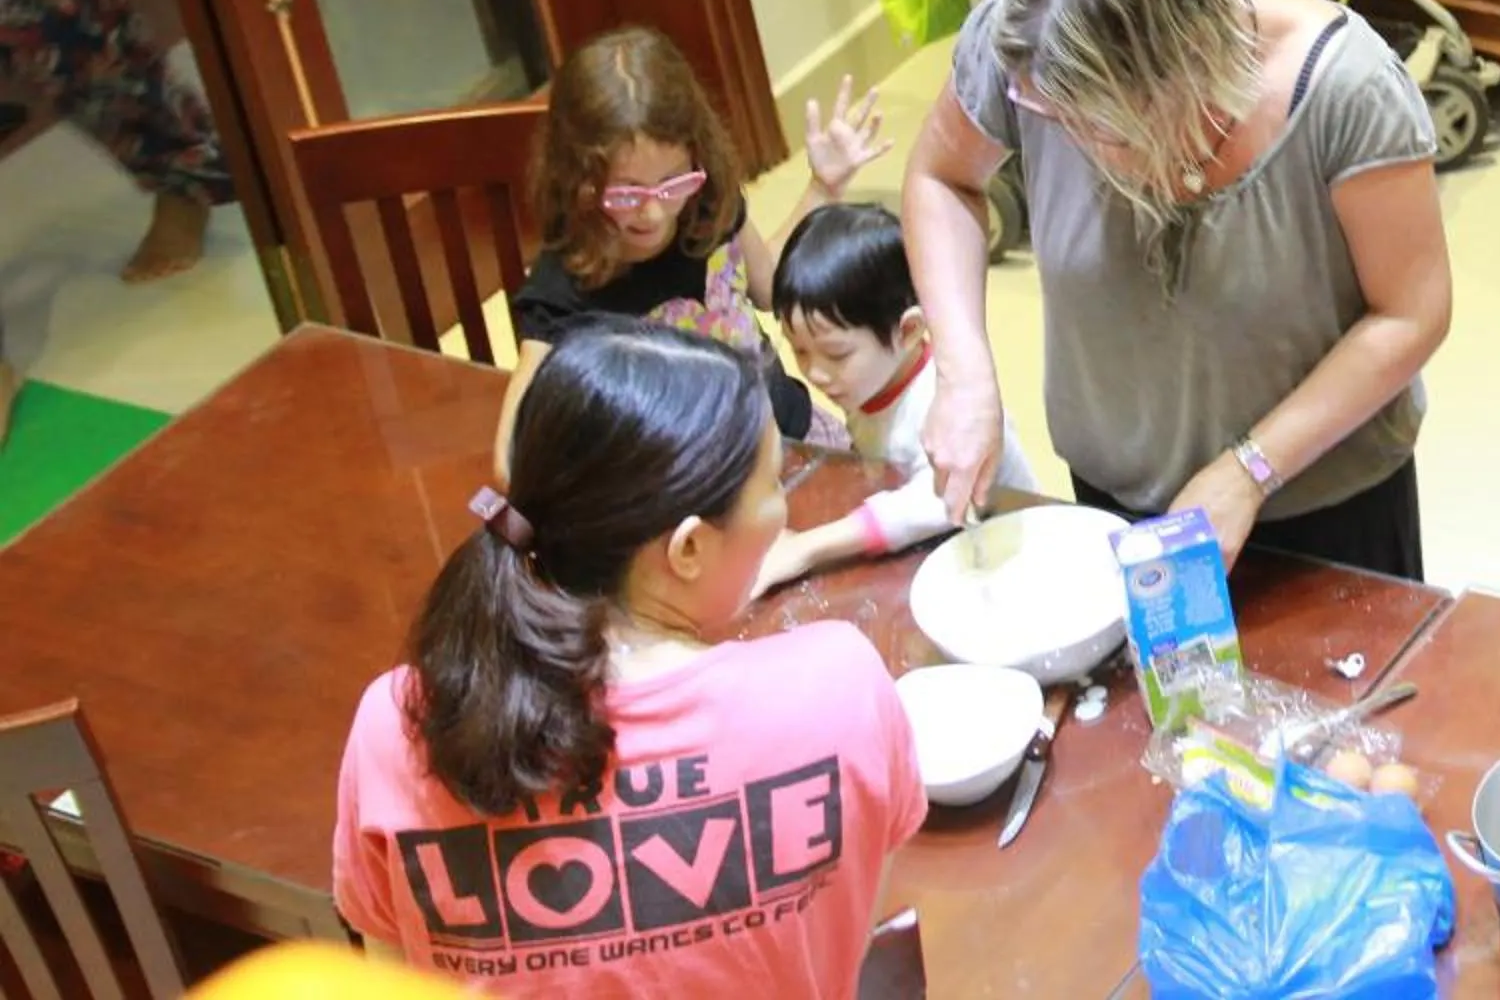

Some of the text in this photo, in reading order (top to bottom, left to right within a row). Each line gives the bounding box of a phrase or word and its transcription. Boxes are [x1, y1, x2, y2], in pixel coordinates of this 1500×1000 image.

[414, 770, 835, 930] LOVE
[432, 953, 517, 976] EVERY
[526, 947, 591, 971] ONE
